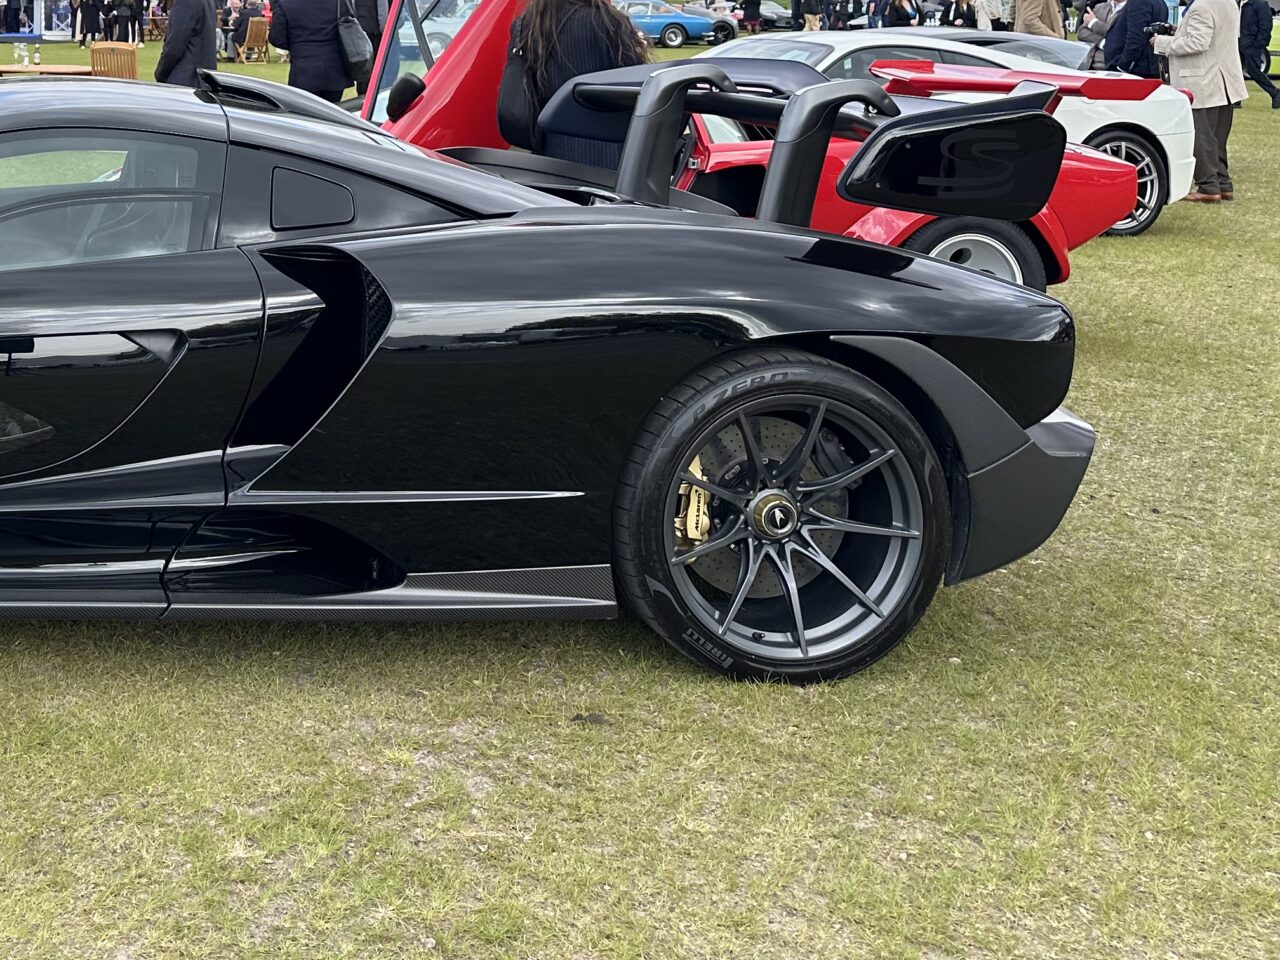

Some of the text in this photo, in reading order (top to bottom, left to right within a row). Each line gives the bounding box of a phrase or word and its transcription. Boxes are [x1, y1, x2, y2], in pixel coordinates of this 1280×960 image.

[712, 371, 790, 403] ZERO
[694, 493, 702, 533] McLaren
[681, 628, 734, 668] PIRELLI
